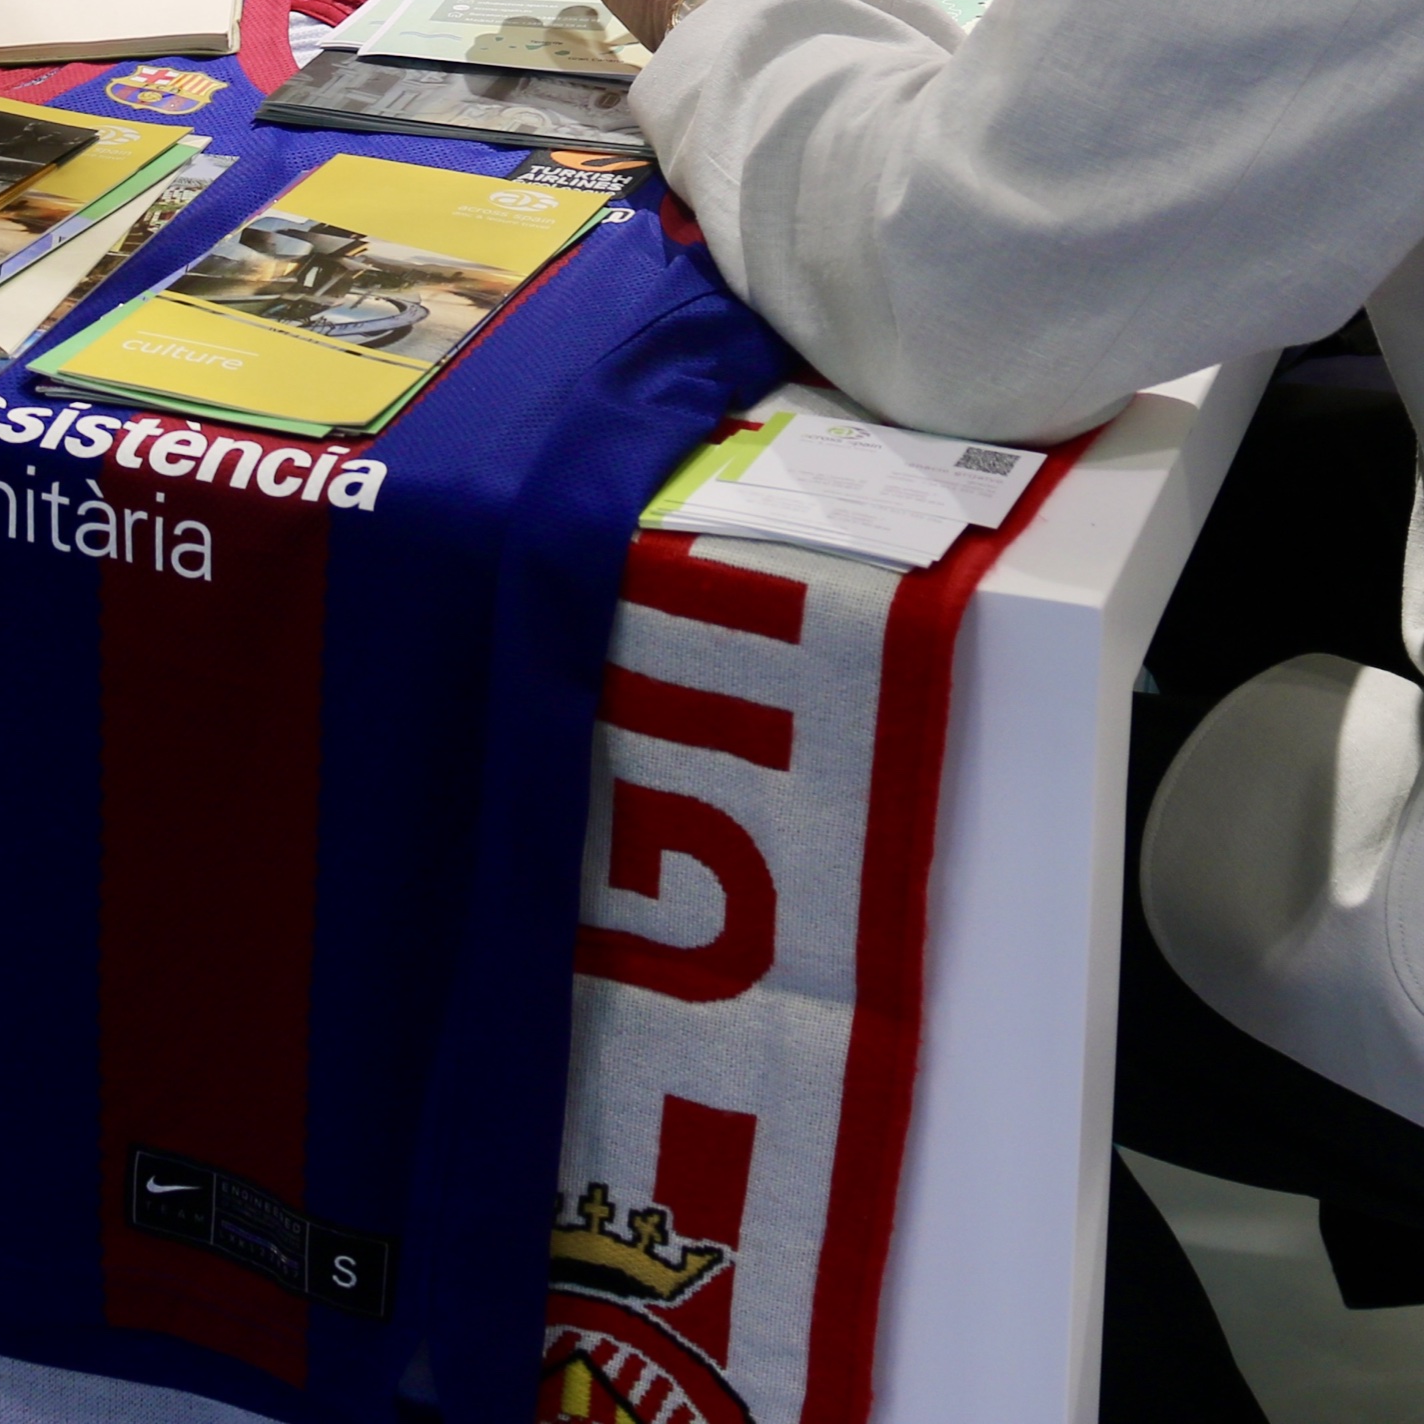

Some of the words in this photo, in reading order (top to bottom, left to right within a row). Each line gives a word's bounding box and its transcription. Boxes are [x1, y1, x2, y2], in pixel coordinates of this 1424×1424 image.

[516, 172, 626, 192] AIRLINES
[530, 164, 633, 185] TURKISH
[456, 204, 509, 218] across
[513, 213, 556, 226] spain
[119, 333, 245, 373] culture
[145, 1200, 206, 1224] TEAM
[332, 1255, 358, 1288] S
